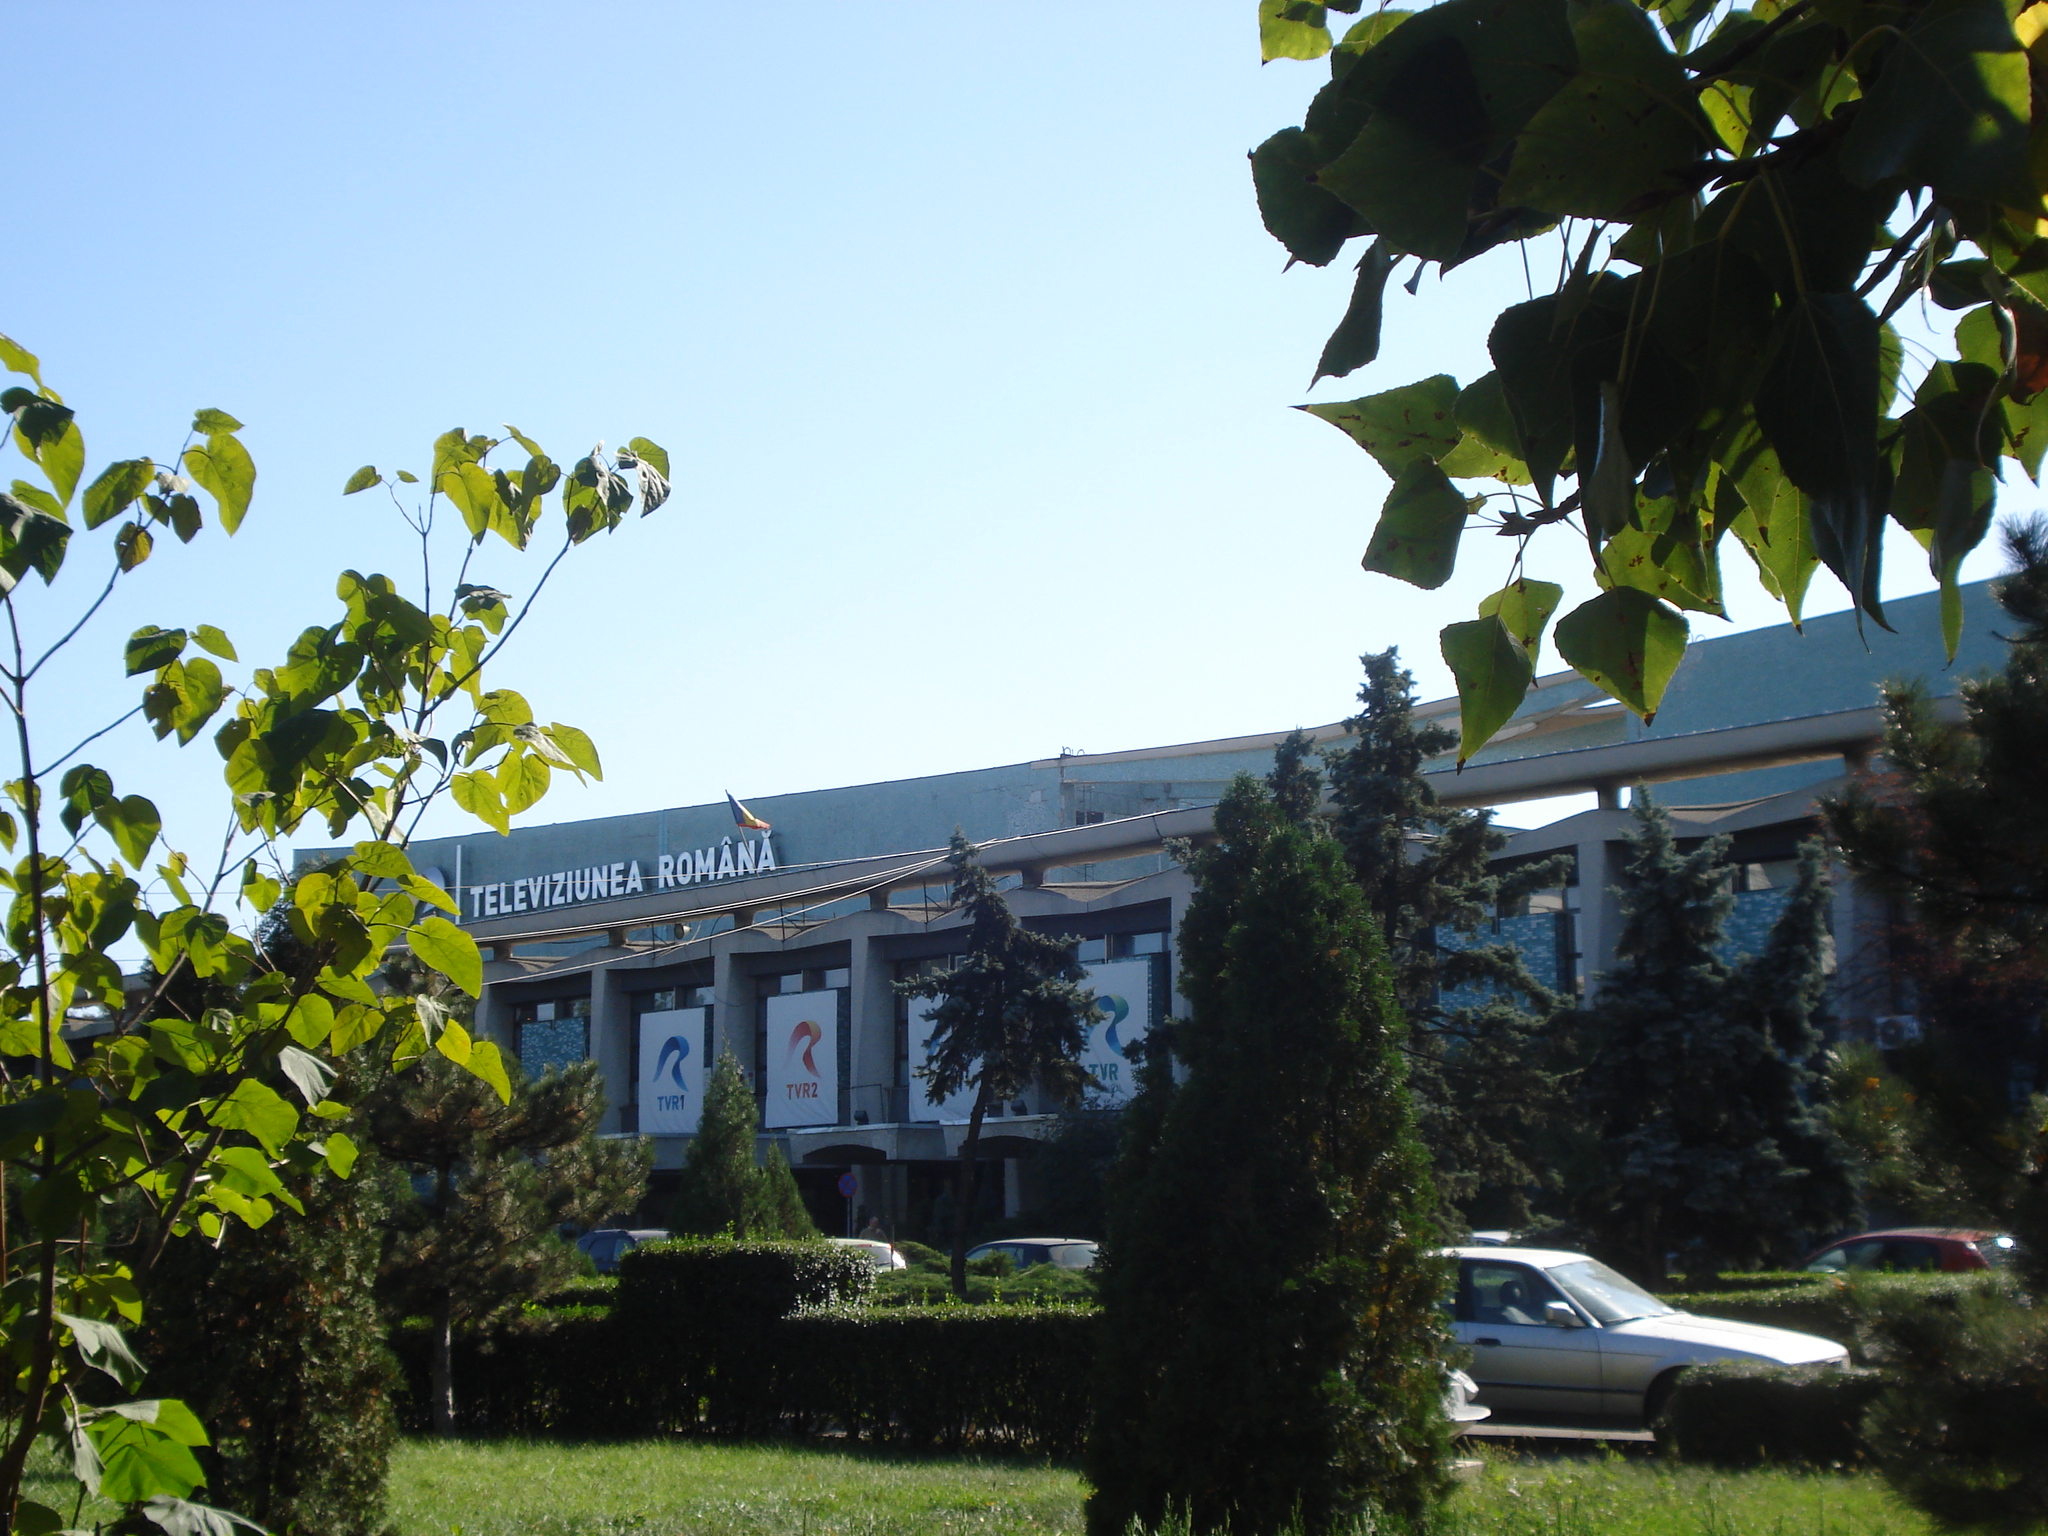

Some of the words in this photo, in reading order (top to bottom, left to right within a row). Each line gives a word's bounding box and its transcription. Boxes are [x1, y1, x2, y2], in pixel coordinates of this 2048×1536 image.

[469, 860, 643, 918] TELEVIZIUNEA
[658, 830, 777, 889] ROMÂNĂ
[1088, 1063, 1118, 1081] TVR
[786, 1082, 818, 1099] TVR2
[657, 1094, 685, 1111] TVR1
